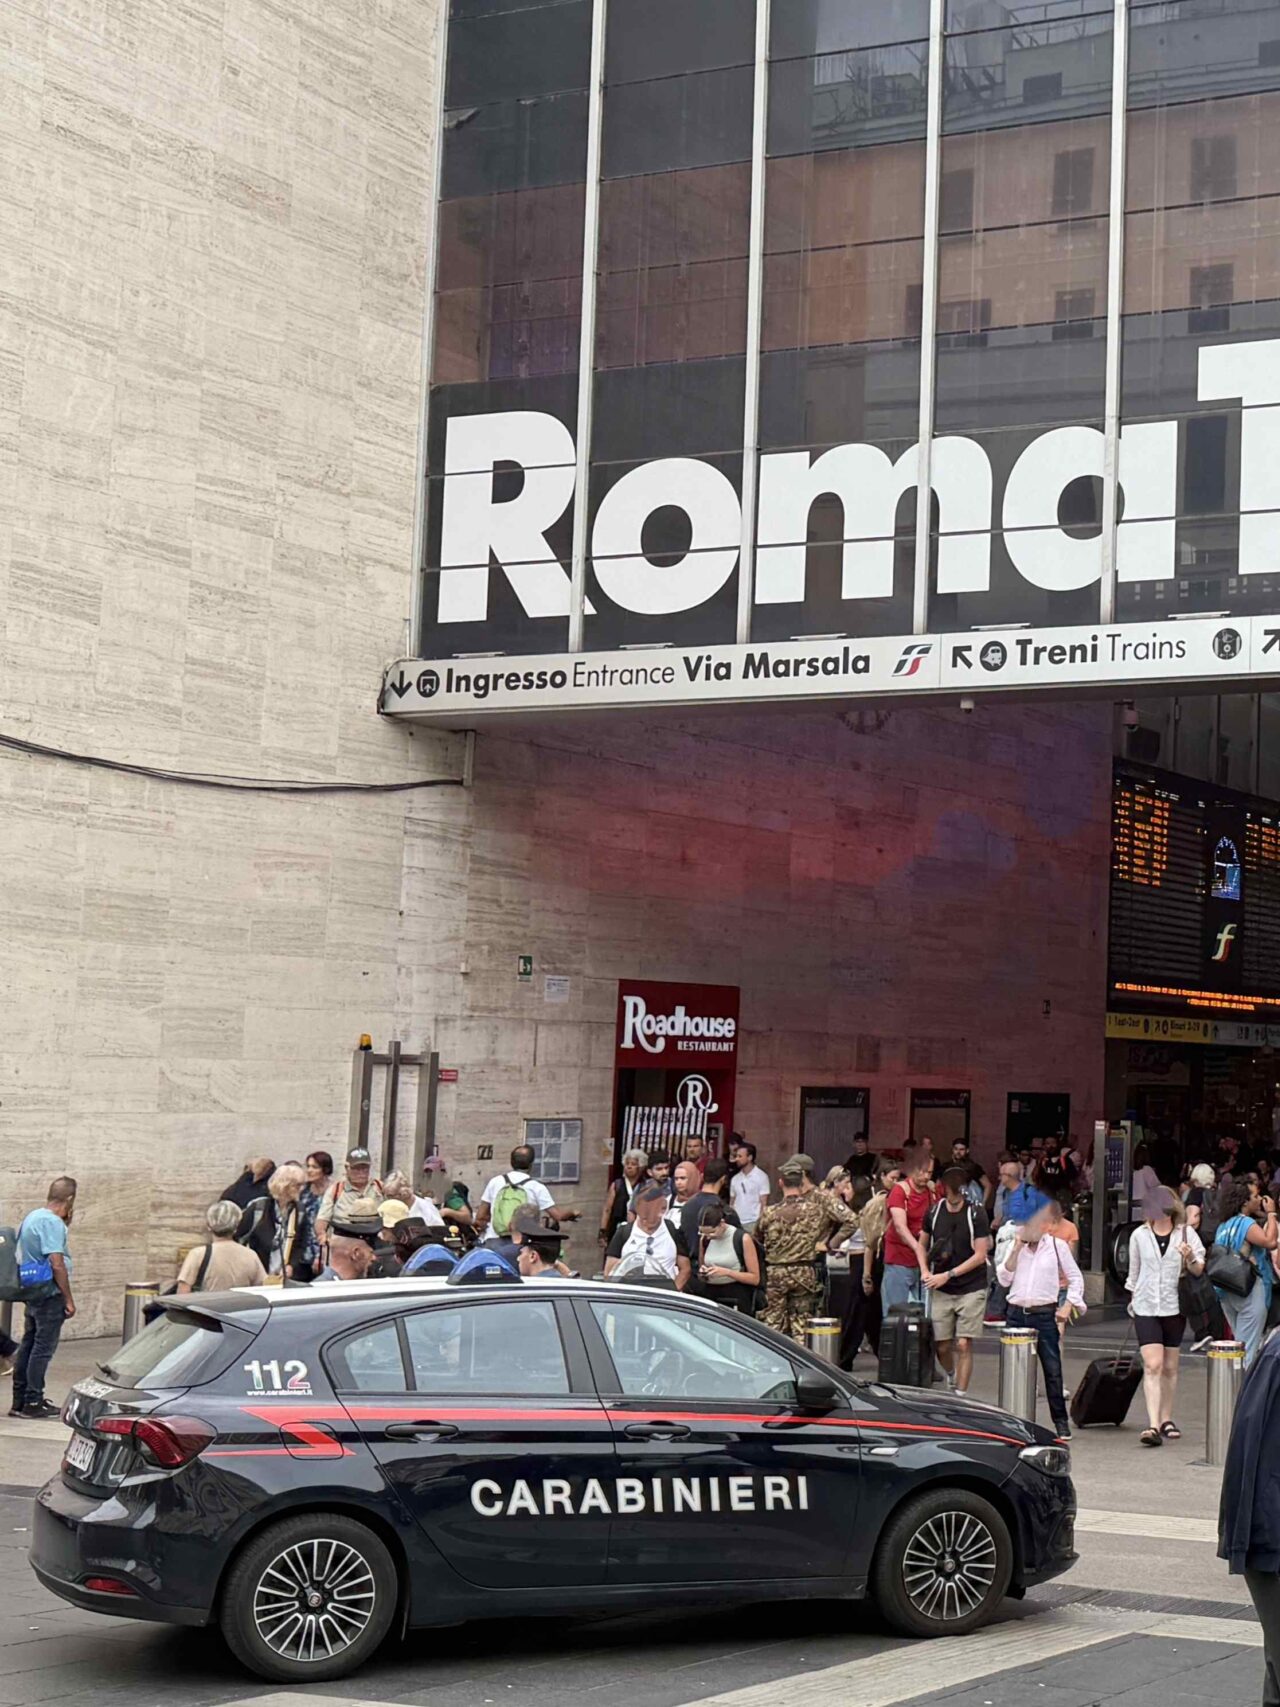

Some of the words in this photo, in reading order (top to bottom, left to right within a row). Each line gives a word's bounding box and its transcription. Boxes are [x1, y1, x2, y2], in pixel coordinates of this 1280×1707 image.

[1016, 636, 1098, 667] Treni
[1105, 632, 1186, 662] Trains
[446, 667, 567, 697] Ingresso
[573, 662, 675, 687] Entrance
[683, 655, 731, 683] Via
[742, 648, 870, 680] Marsala
[621, 995, 735, 1053] Roadhouse
[677, 1040, 735, 1052] RESTAURANT
[244, 1360, 310, 1390] 112
[470, 1475, 811, 1516] CARABINIERI
